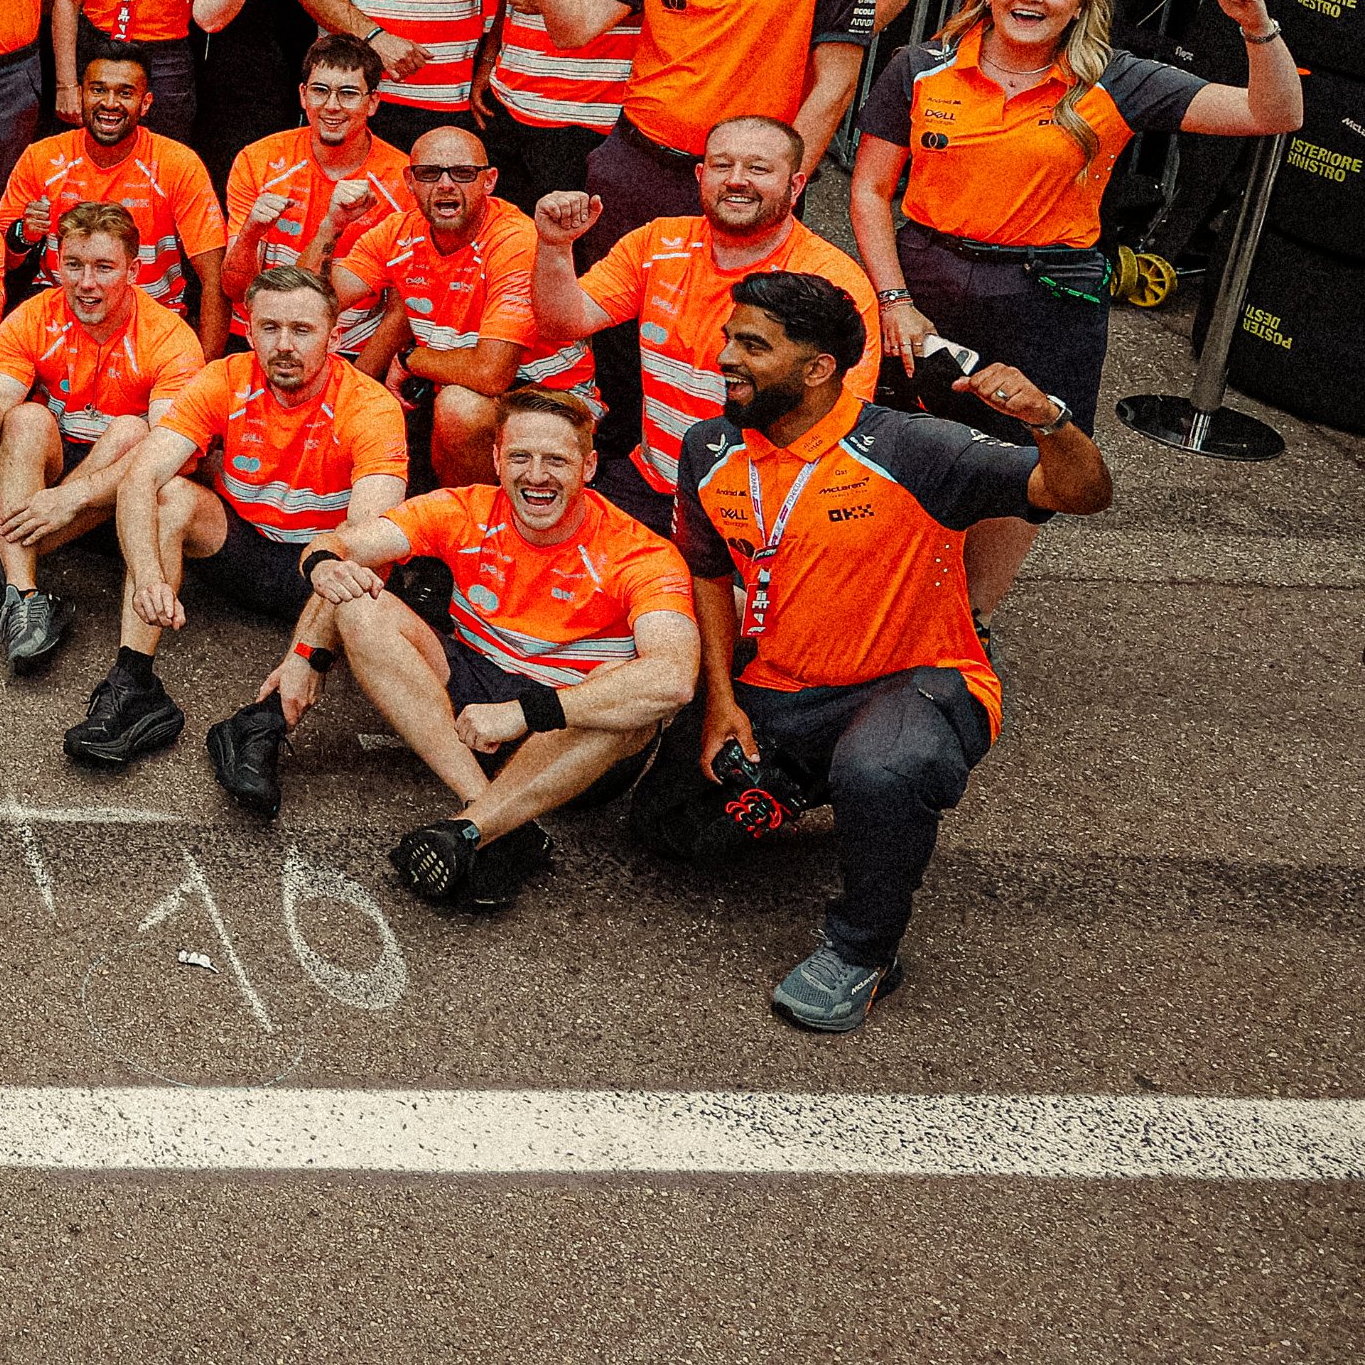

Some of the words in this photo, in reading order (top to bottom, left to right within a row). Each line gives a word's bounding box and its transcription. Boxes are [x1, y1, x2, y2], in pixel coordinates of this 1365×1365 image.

[924, 109, 955, 121] DELL
[1291, 137, 1363, 173] STERIORE
[819, 480, 861, 494] McLaren
[720, 508, 748, 520] DELL
